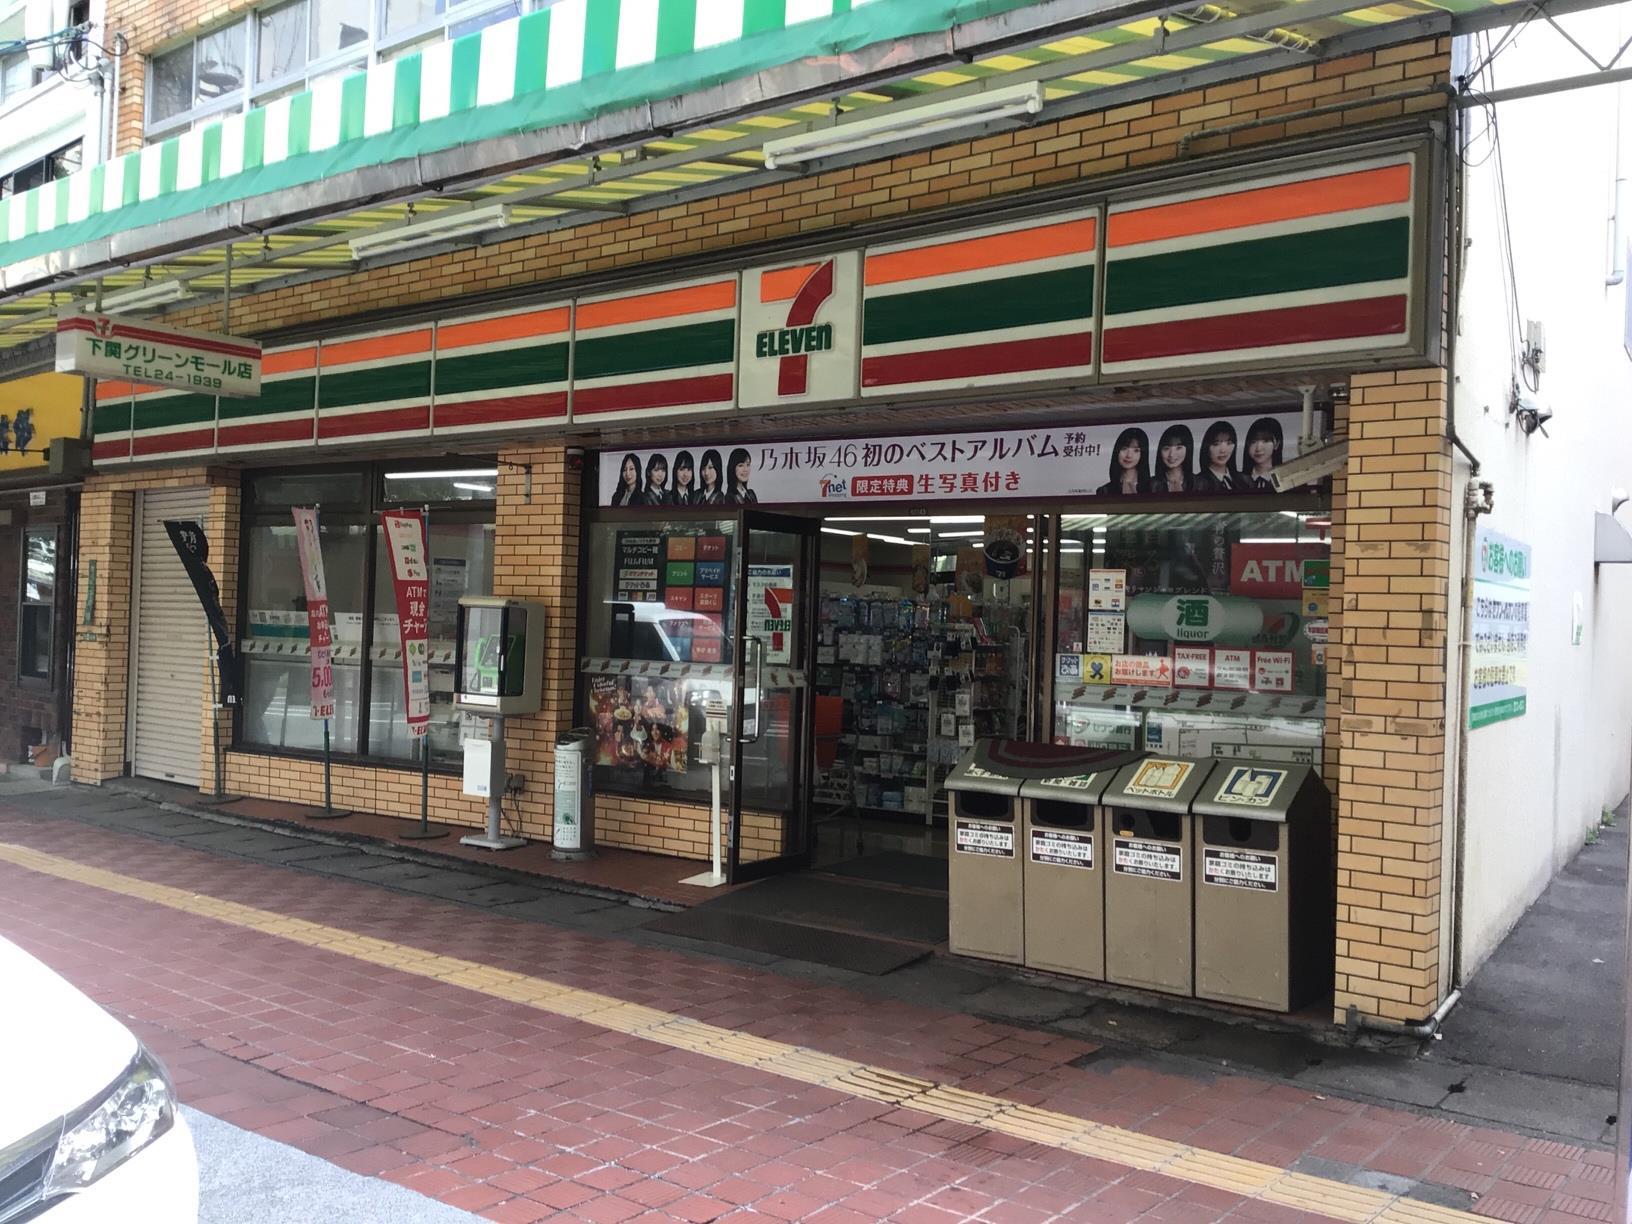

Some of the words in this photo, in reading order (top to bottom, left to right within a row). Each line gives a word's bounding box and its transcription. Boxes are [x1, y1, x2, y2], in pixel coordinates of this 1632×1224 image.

[86, 337, 253, 379] 下関グリーンモール店
[1063, 432, 1087, 443] 予約
[855, 479, 910, 493] 限定特典
[917, 472, 1021, 494] 生写真付き
[1240, 559, 1304, 583] ATM
[1176, 599, 1210, 627] 酒
[1176, 628, 1209, 640] liquor
[1224, 654, 1241, 662] ATM
[1257, 656, 1272, 664] Free
[1126, 786, 1175, 797] ペットボトル
